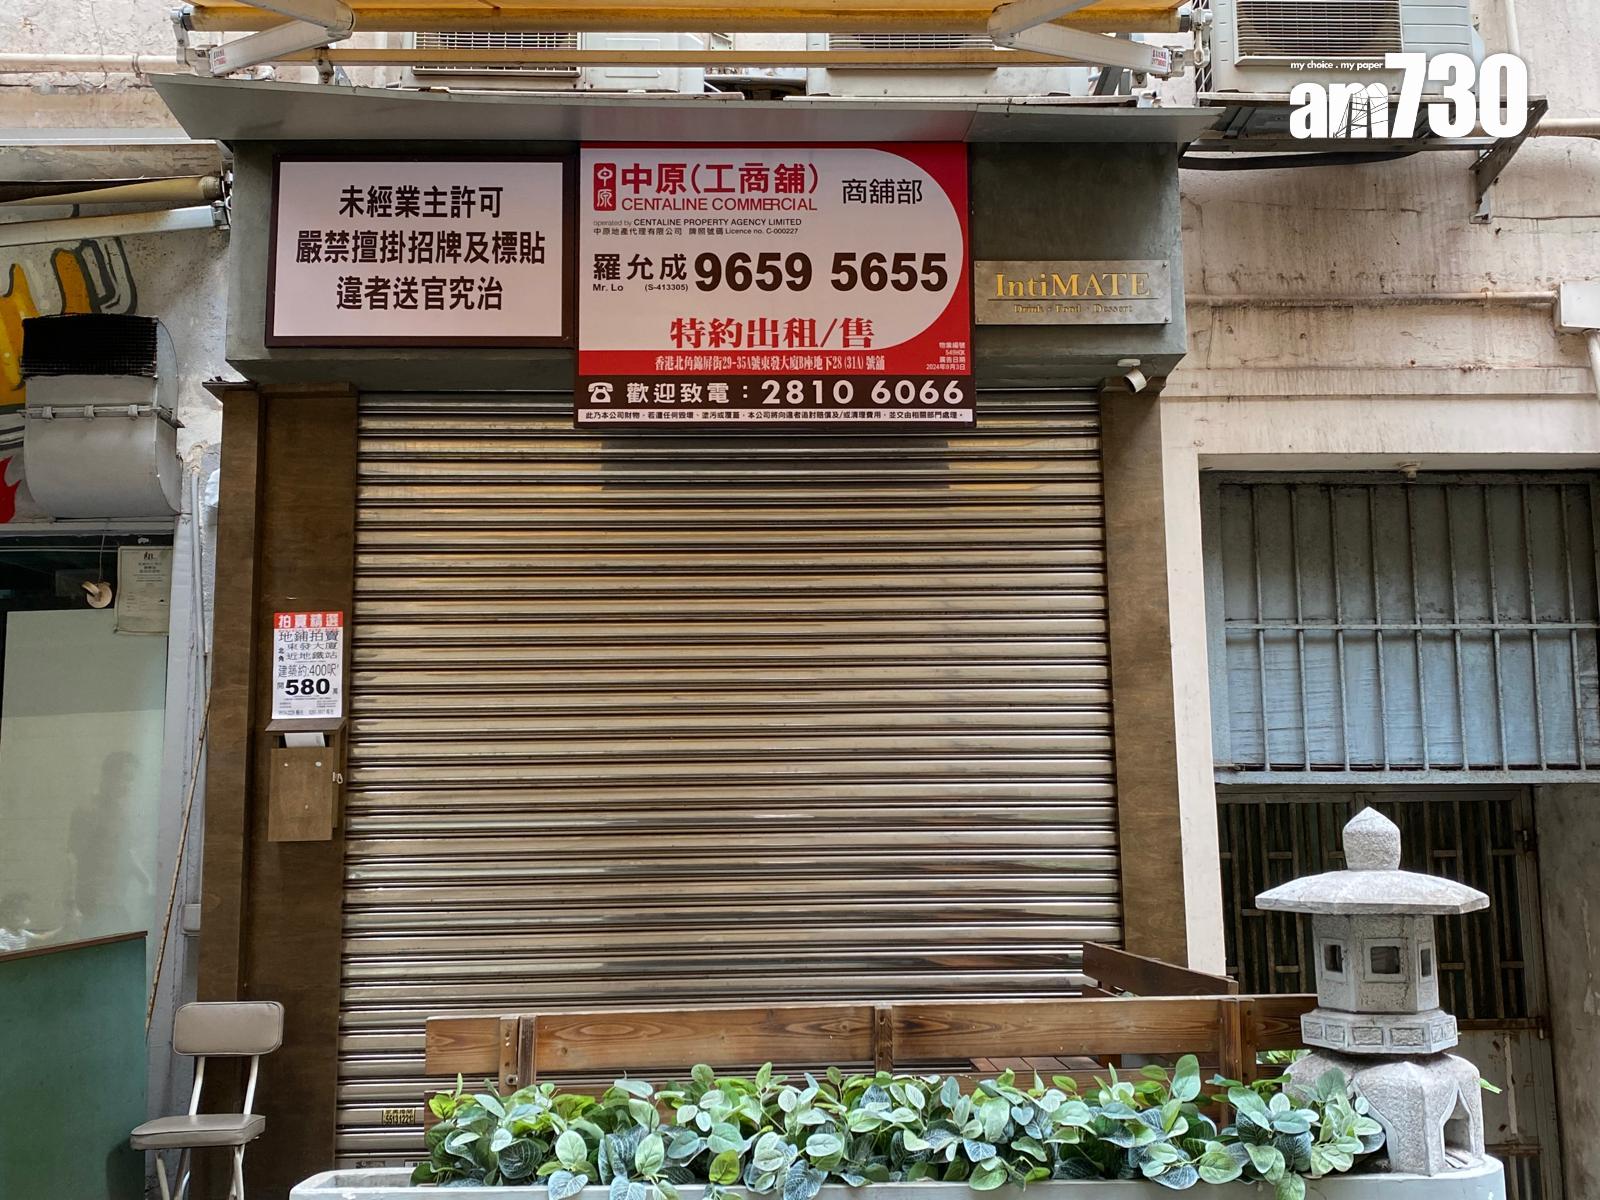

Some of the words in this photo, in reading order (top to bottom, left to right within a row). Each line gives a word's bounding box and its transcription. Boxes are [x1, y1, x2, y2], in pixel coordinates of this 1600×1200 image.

[339, 185, 503, 218] 未經業主許可
[621, 197, 708, 211] CENTALINE
[712, 197, 818, 211] COMMERCIAL
[841, 178, 923, 205] 商舖部
[593, 219, 623, 227] operated
[623, 219, 633, 228] by
[296, 230, 546, 264] 嚴禁擅掛招牌及標貼
[593, 253, 688, 281] 羅允成
[694, 251, 813, 293] 9659
[830, 252, 948, 293] 5655
[994, 271, 1151, 297] IntiMATE
[336, 276, 504, 311] 違者送官究治
[592, 283, 609, 292] Mr.
[611, 283, 624, 292] Lo
[644, 283, 689, 292] (S-413305)
[1013, 304, 1044, 314] Drink
[1055, 304, 1082, 314] Food
[1093, 303, 1133, 314] Dessert
[669, 317, 876, 349] 特約出租/售
[761, 379, 854, 405] 2810
[871, 379, 964, 405] 6066
[285, 678, 330, 696] 580
